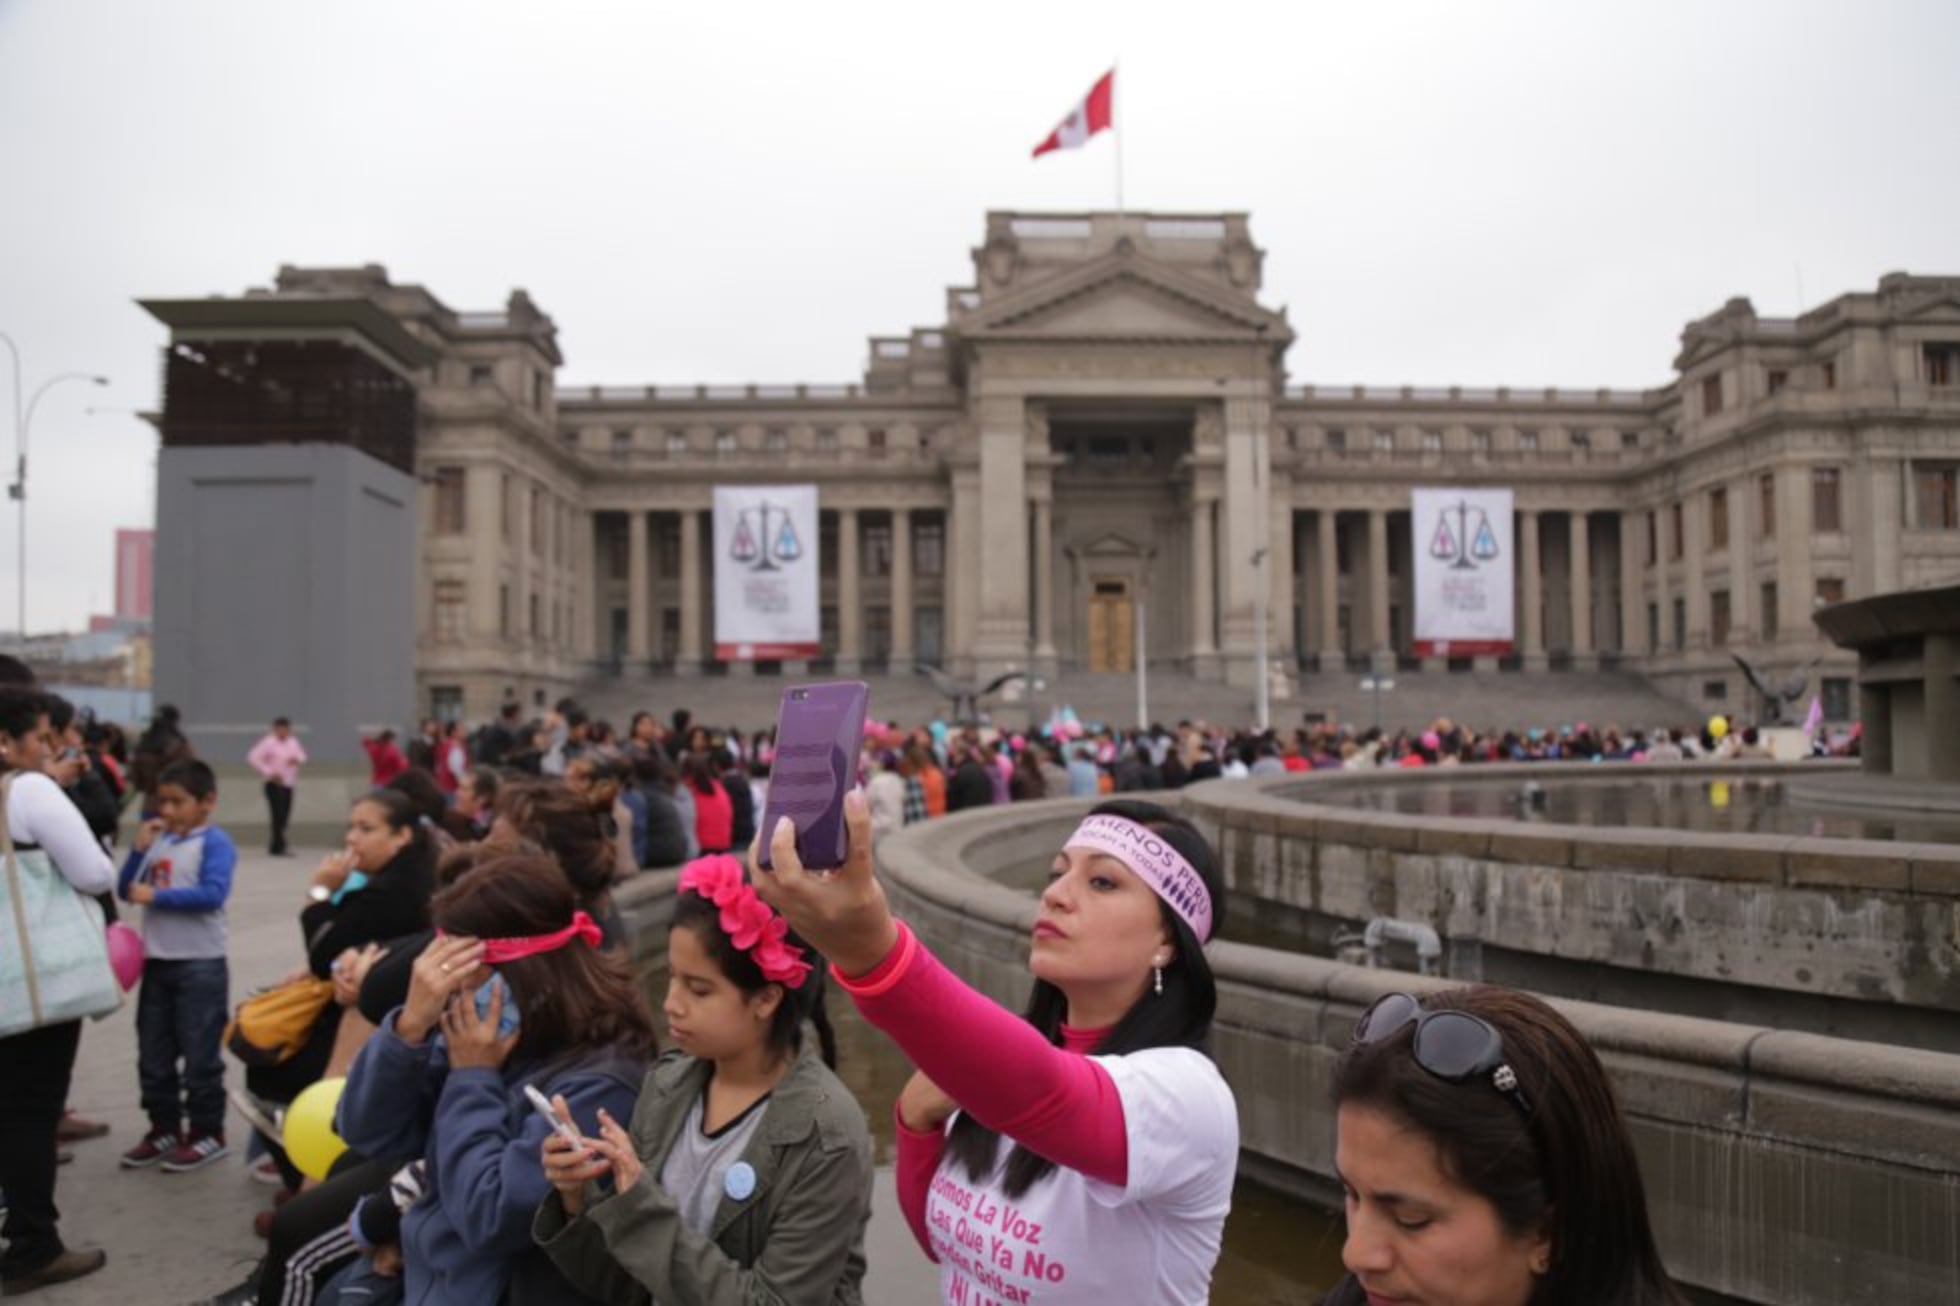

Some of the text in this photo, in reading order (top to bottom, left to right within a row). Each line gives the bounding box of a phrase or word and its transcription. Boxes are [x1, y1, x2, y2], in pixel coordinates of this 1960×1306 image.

[1099, 818, 1176, 868] MENOS
[931, 1198, 1066, 1284] Las Que Ya No
[973, 1193, 997, 1226] La
[1001, 1205, 1042, 1246] Voz
[974, 1260, 1031, 1305] Gritar
